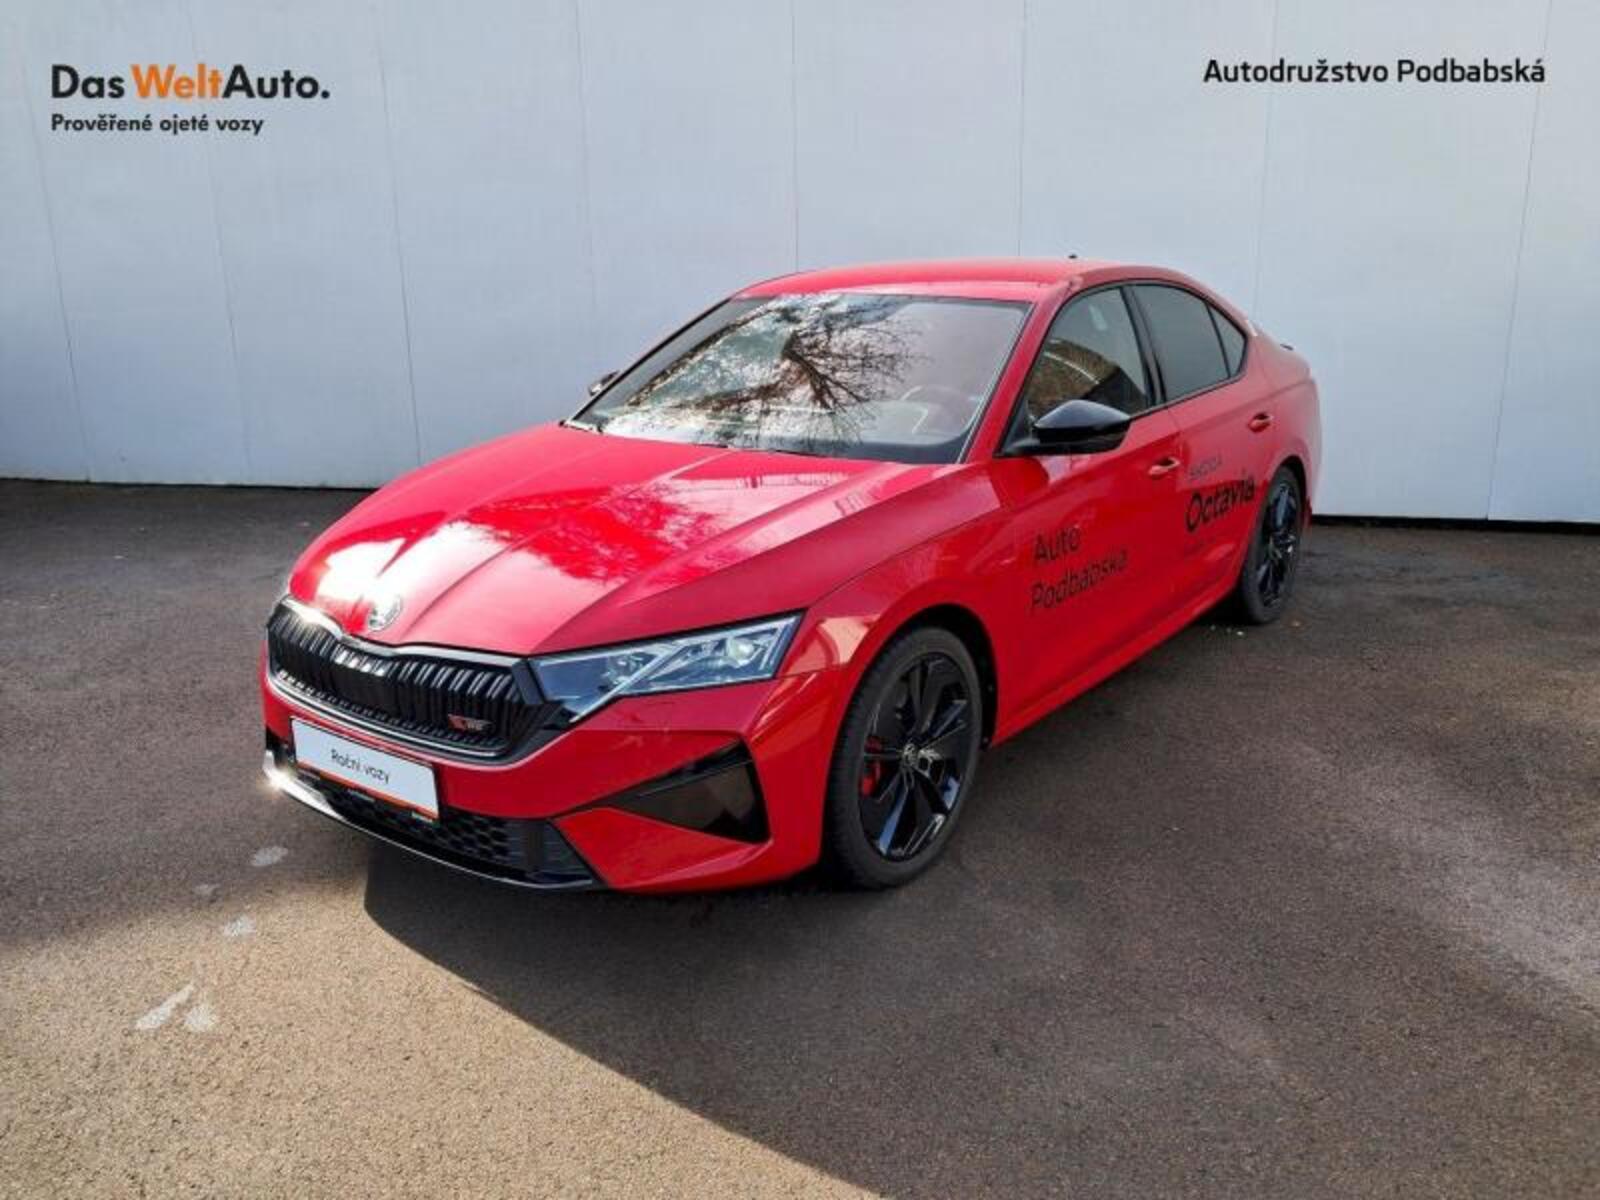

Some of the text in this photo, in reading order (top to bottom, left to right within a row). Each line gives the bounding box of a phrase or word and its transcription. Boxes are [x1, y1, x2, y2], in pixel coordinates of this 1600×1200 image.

[1185, 468, 1256, 533] Octavia
[1033, 528, 1082, 563] Auto
[362, 763, 390, 785] vozy
